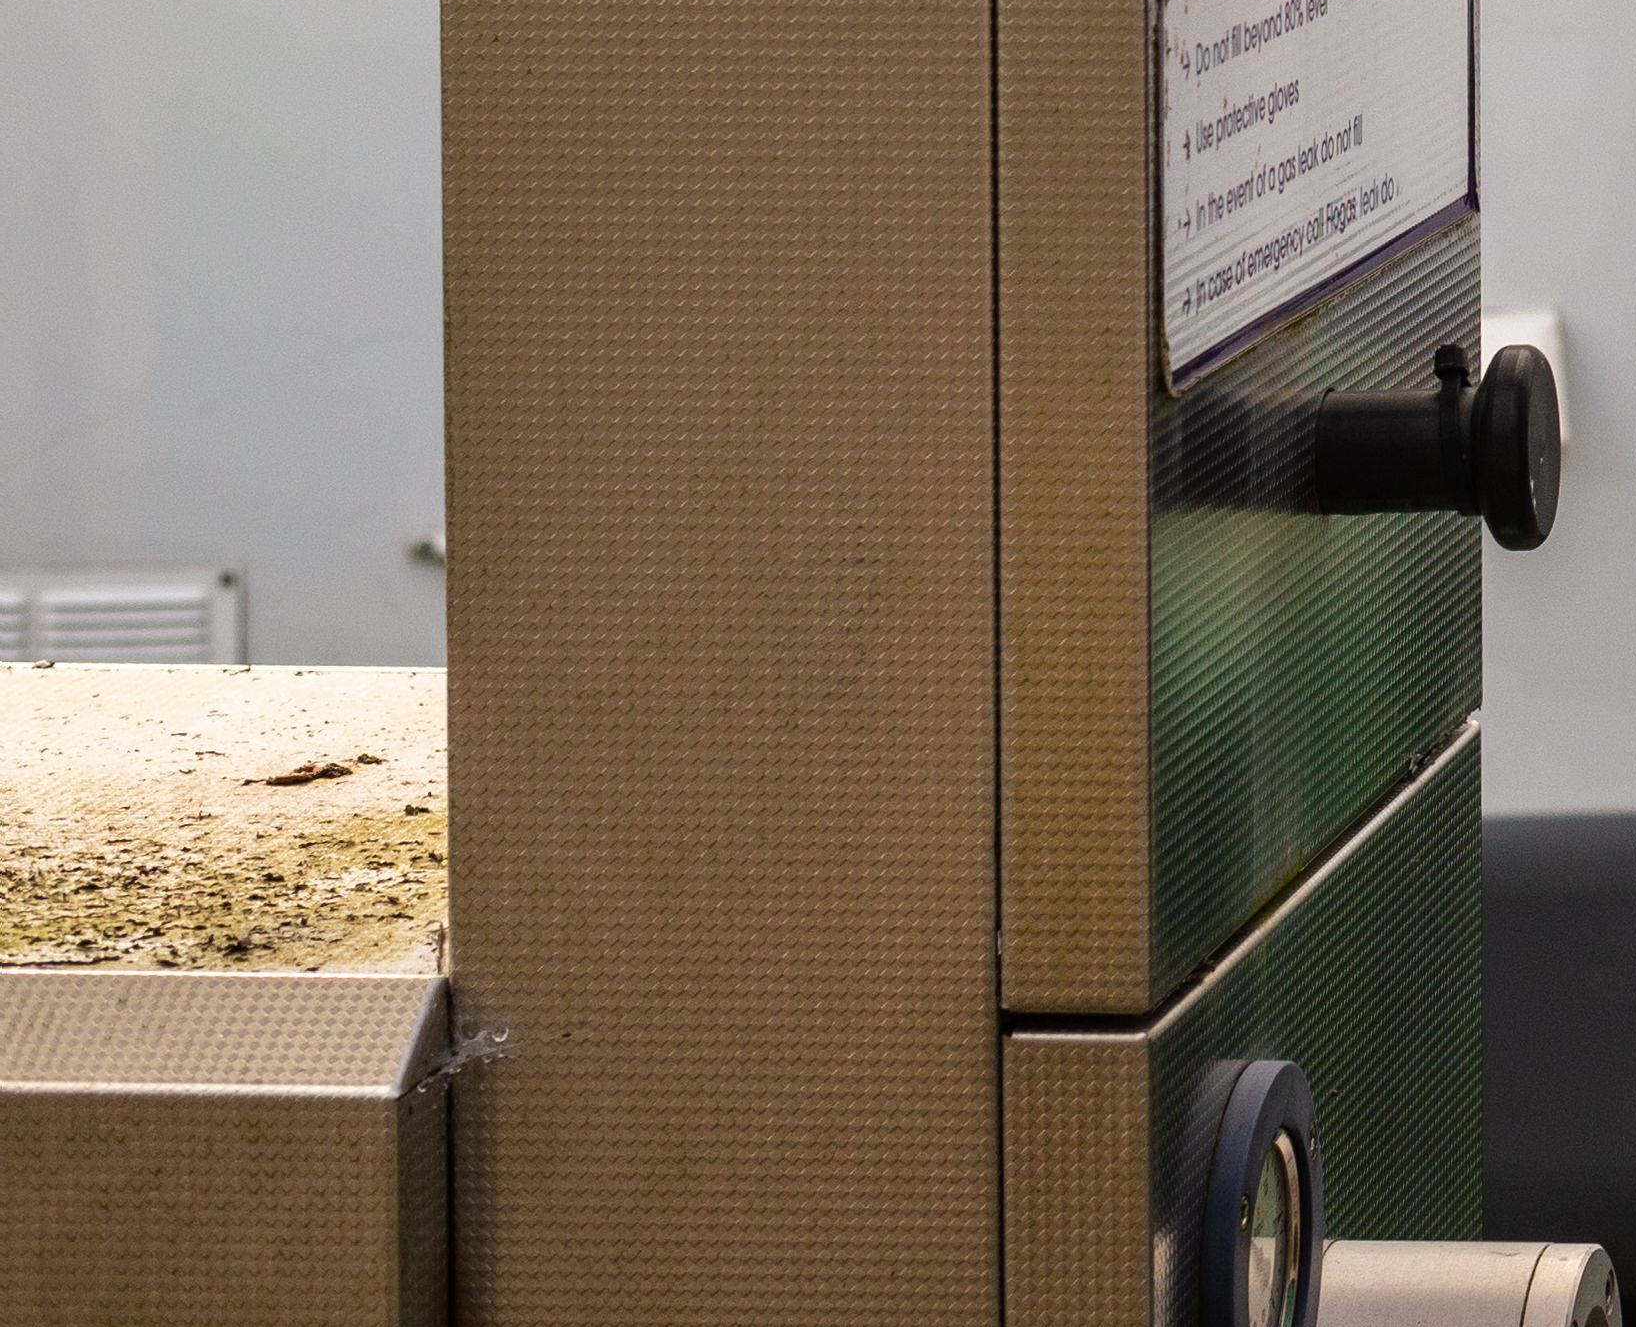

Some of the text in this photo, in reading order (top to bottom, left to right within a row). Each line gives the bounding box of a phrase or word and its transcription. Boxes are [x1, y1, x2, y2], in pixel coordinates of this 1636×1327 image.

[1195, 42, 1211, 76] Do
[1213, 29, 1230, 68] not
[1243, 4, 1282, 53] beyond
[1196, 79, 1299, 153] Use protective gloves
[1196, 198, 1206, 232] In
[1207, 192, 1224, 225] the
[1226, 171, 1254, 214] event
[1256, 163, 1266, 197] of
[1268, 166, 1275, 191] a
[1278, 156, 1296, 194] gas
[1298, 137, 1318, 175] leak
[1321, 131, 1334, 163] do
[1336, 119, 1351, 156] not
[1208, 265, 1233, 301] case
[1235, 250, 1247, 285] of
[1247, 223, 1305, 276] emergency
[1306, 206, 1324, 244] call
[1381, 172, 1394, 204] do
